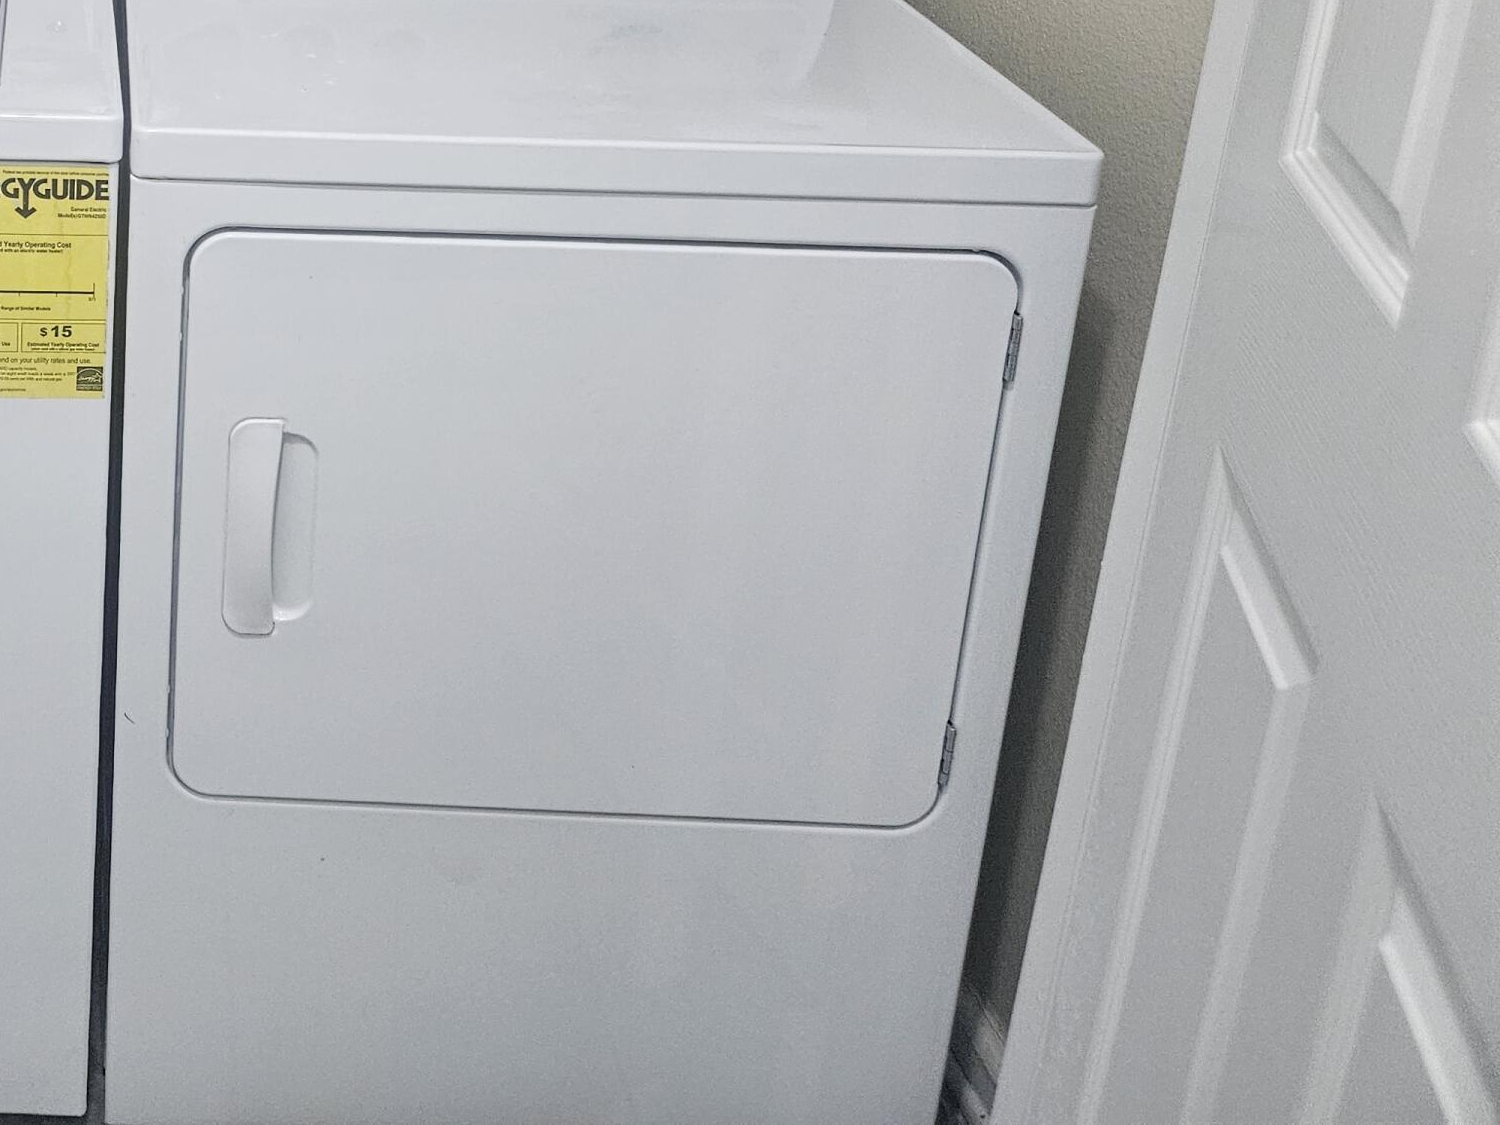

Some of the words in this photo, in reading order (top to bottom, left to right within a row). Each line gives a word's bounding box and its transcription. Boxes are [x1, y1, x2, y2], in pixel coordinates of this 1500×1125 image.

[24, 241, 56, 249] Operating
[40, 327, 48, 337] $
[51, 326, 72, 337] 15
[33, 357, 49, 365] utility
